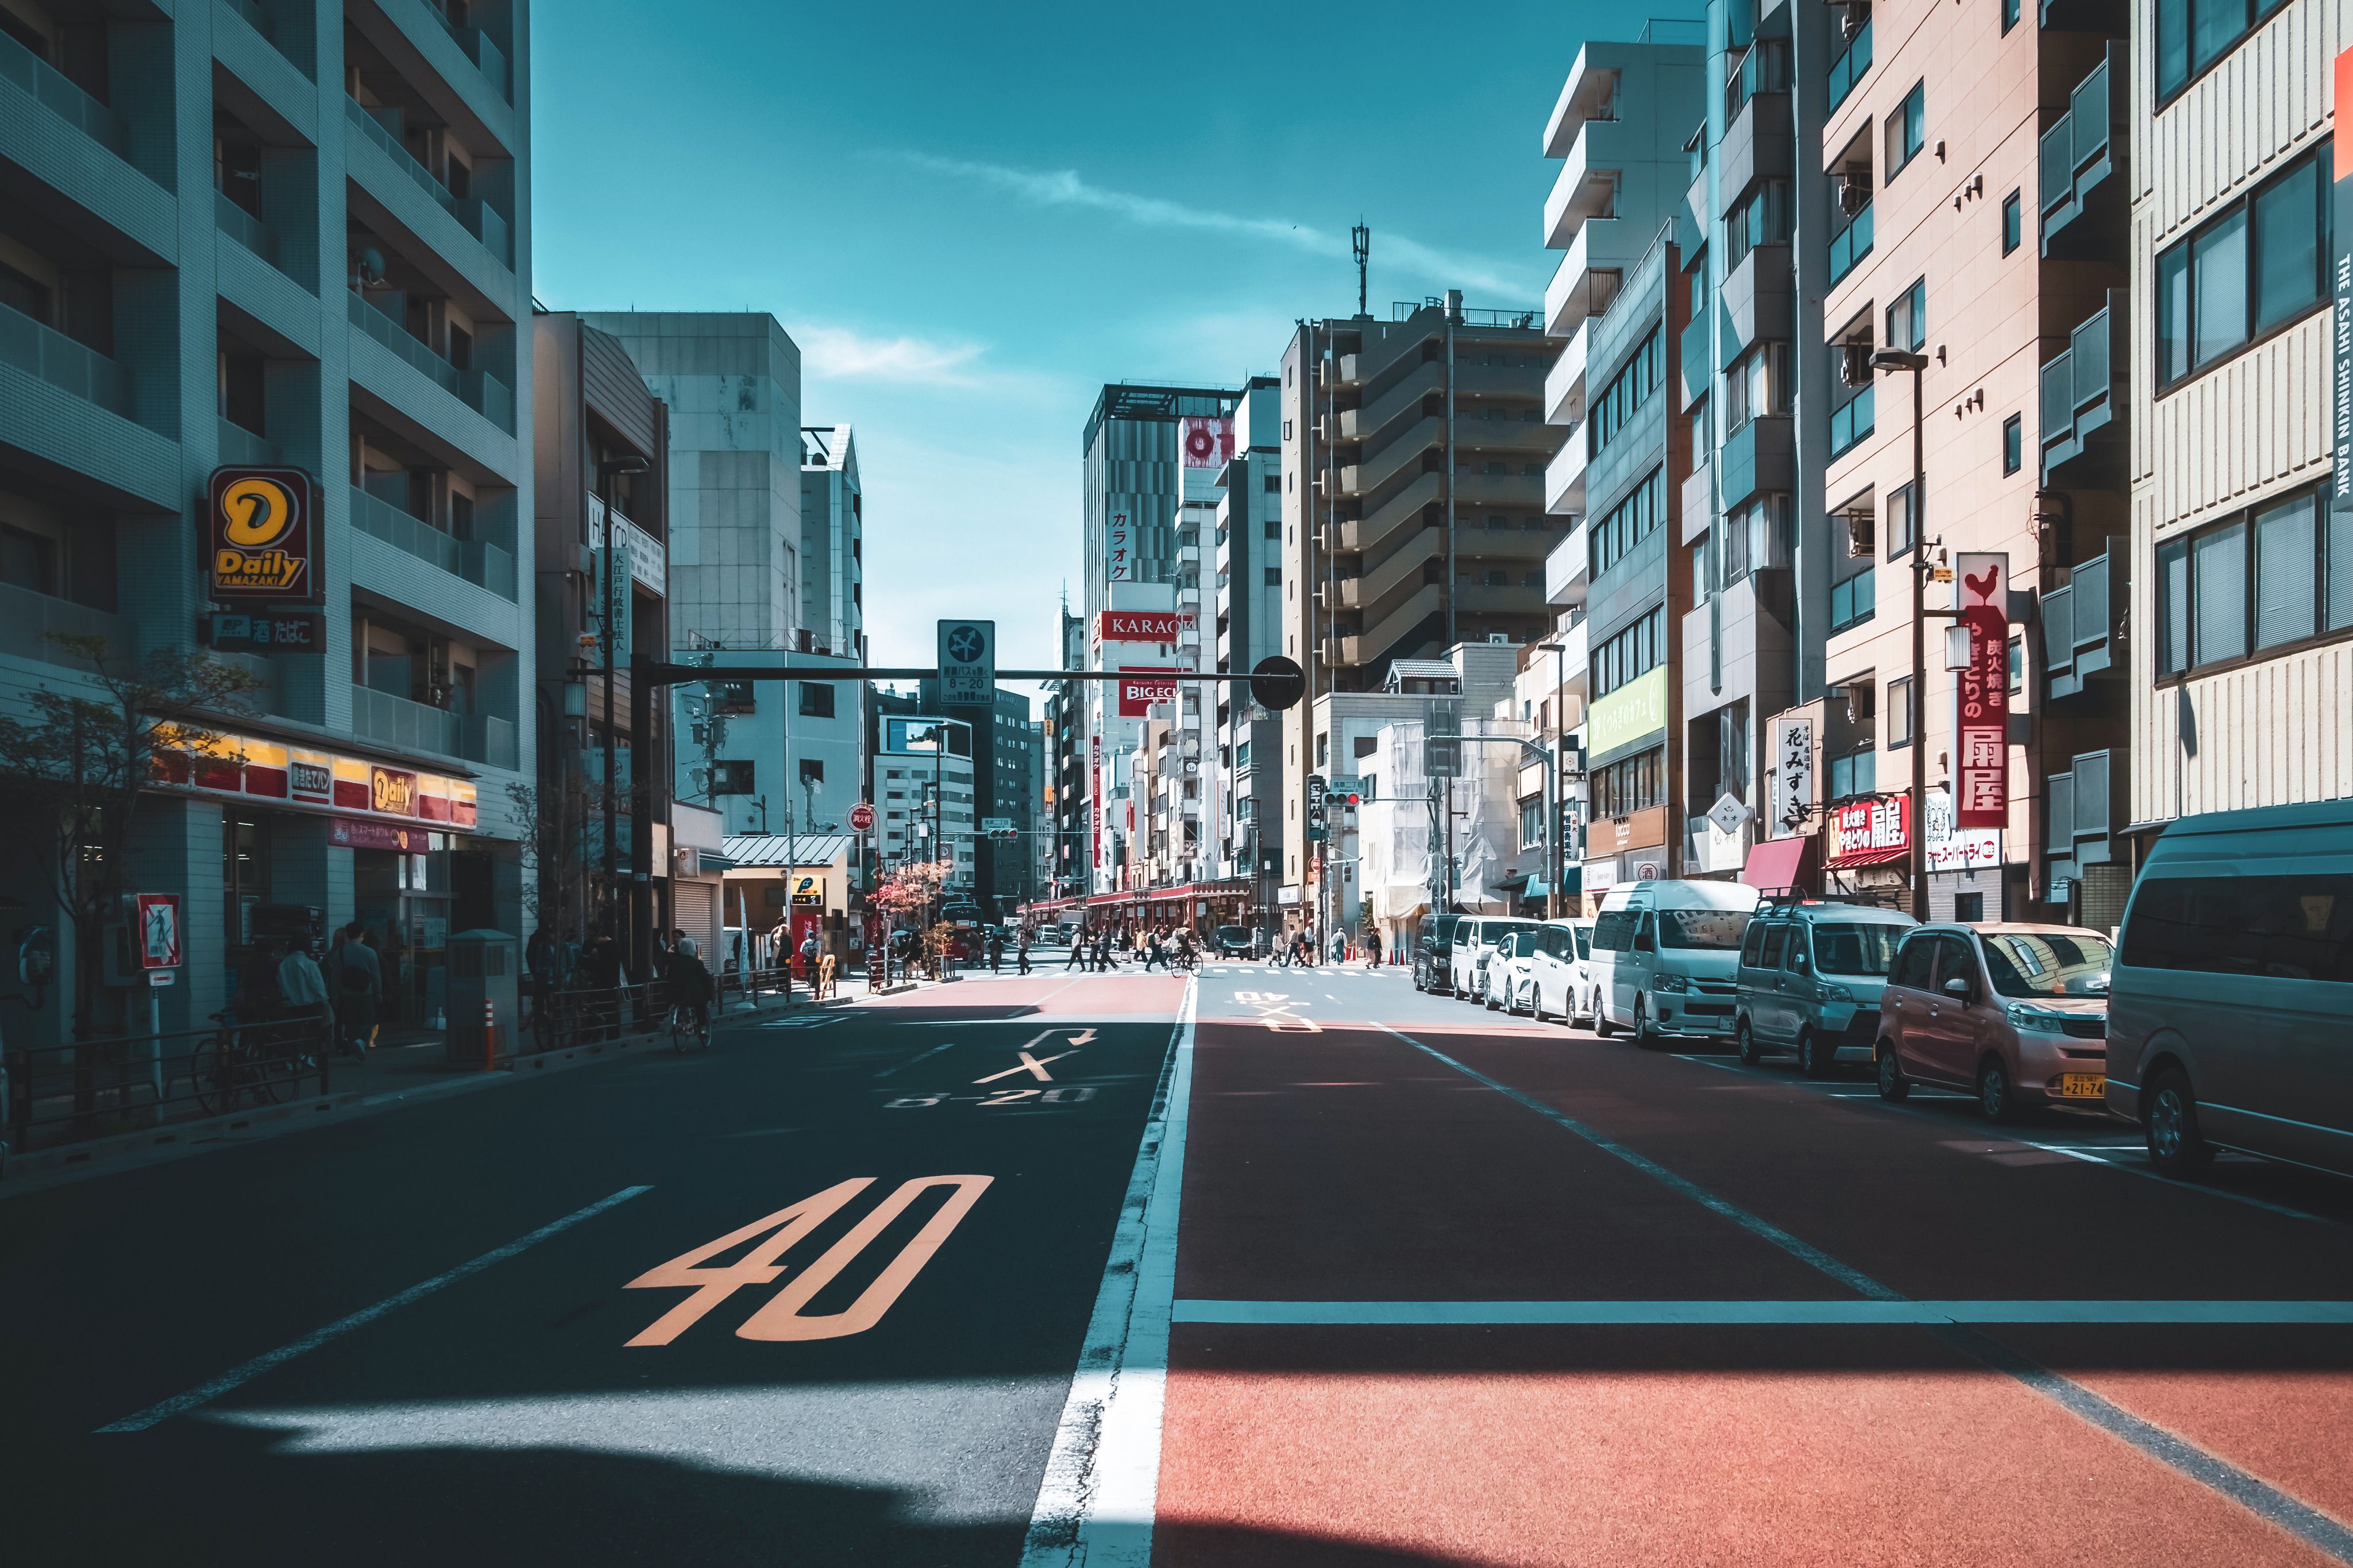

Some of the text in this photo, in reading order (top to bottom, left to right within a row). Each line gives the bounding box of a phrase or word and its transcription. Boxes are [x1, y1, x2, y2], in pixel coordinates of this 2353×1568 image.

[2337, 253, 2350, 498] THE ASAHI SHINKIN BANK
[1112, 513, 1127, 579] カラオケ
[217, 551, 300, 587] Daily
[217, 575, 277, 586] YAMAZAKI
[613, 553, 624, 651] 大江戸行政書士法人
[252, 620, 311, 643] 酒 たばこ
[1986, 639, 2003, 707] 炭火焼き
[1127, 686, 1154, 700] BIG
[1803, 725, 1809, 740] そば
[1962, 725, 2004, 811] 扇屋
[375, 770, 412, 812] Daily
[1310, 783, 1320, 810] CAFE
[853, 814, 871, 824] 消火栓
[1563, 814, 1572, 860] 増田青果店
[1839, 829, 1870, 852] やきとりの
[1642, 868, 1653, 879] 酒
[623, 1175, 995, 1347] 40
